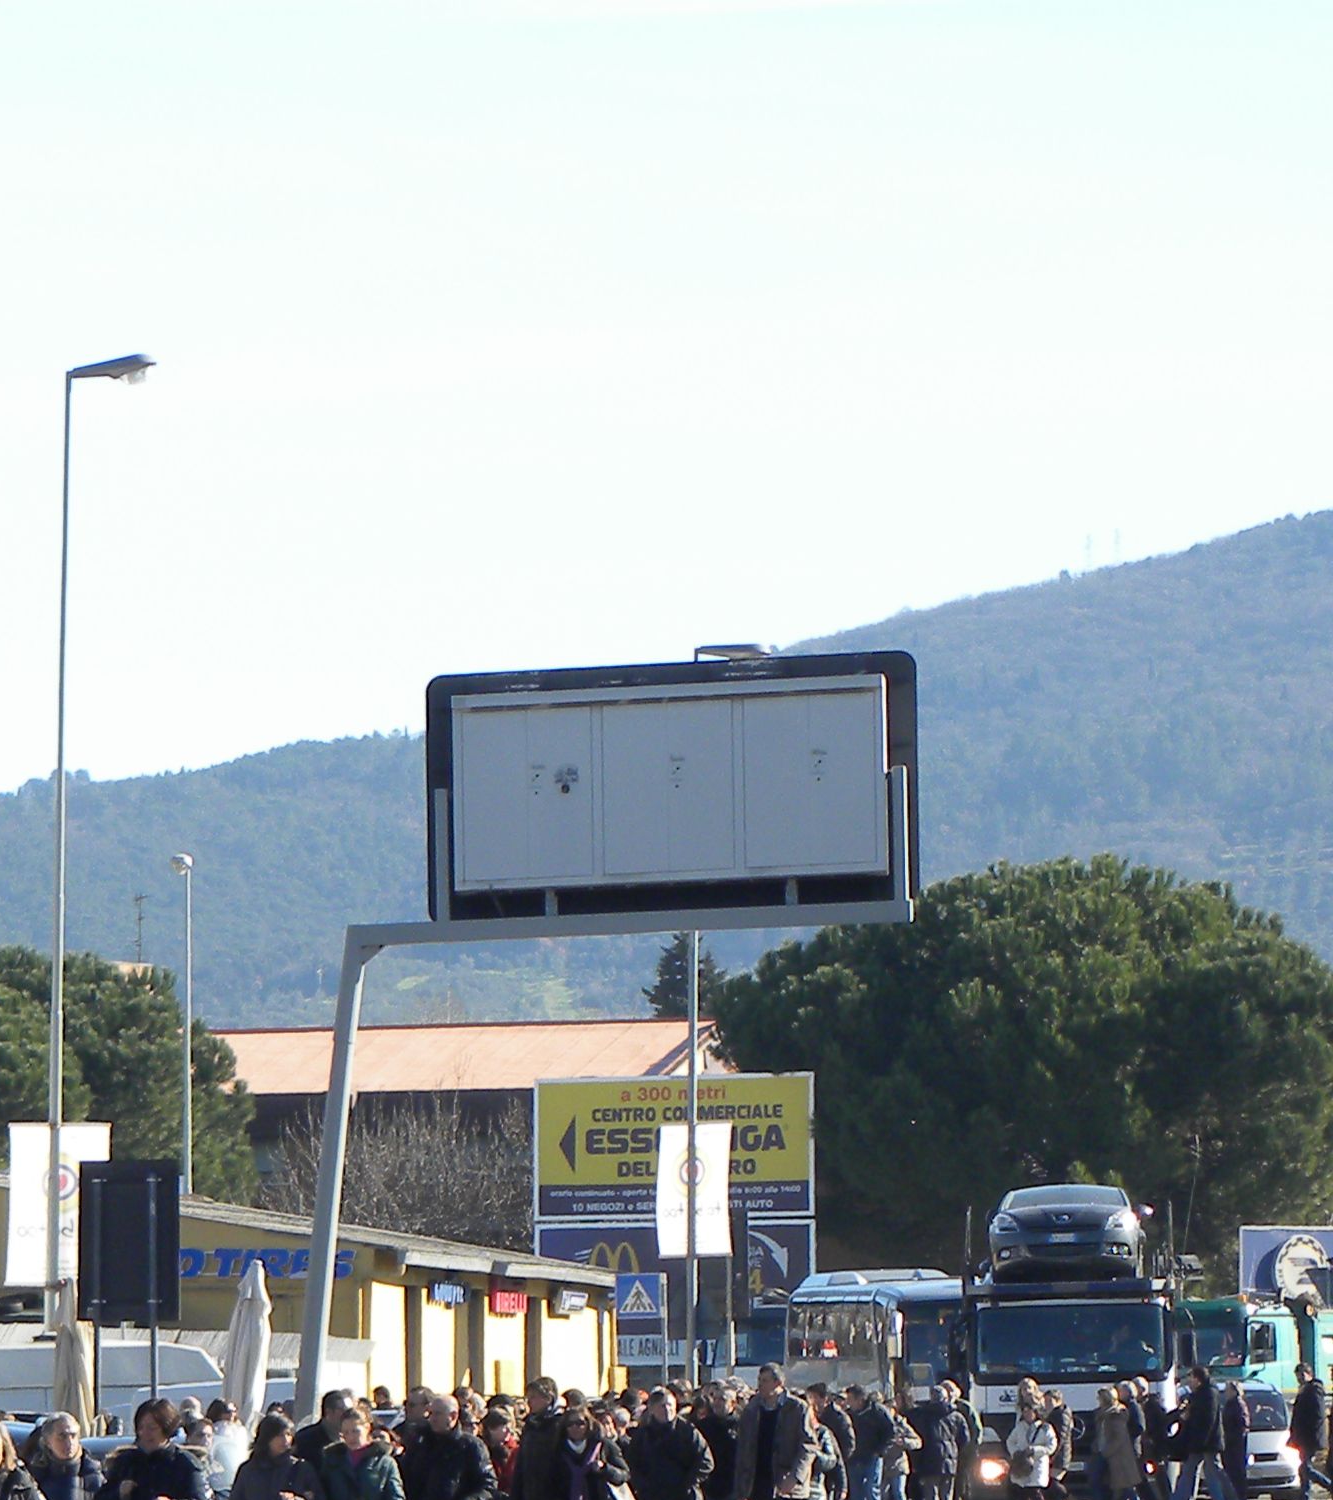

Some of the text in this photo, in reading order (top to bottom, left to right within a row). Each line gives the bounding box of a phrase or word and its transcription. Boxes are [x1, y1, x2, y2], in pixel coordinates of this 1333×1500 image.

[620, 1090, 631, 1101] a
[637, 1086, 672, 1101] 300
[592, 1107, 656, 1123] CENTRO
[586, 1202, 625, 1212] NEGOZI
[745, 1199, 774, 1208] AUTO
